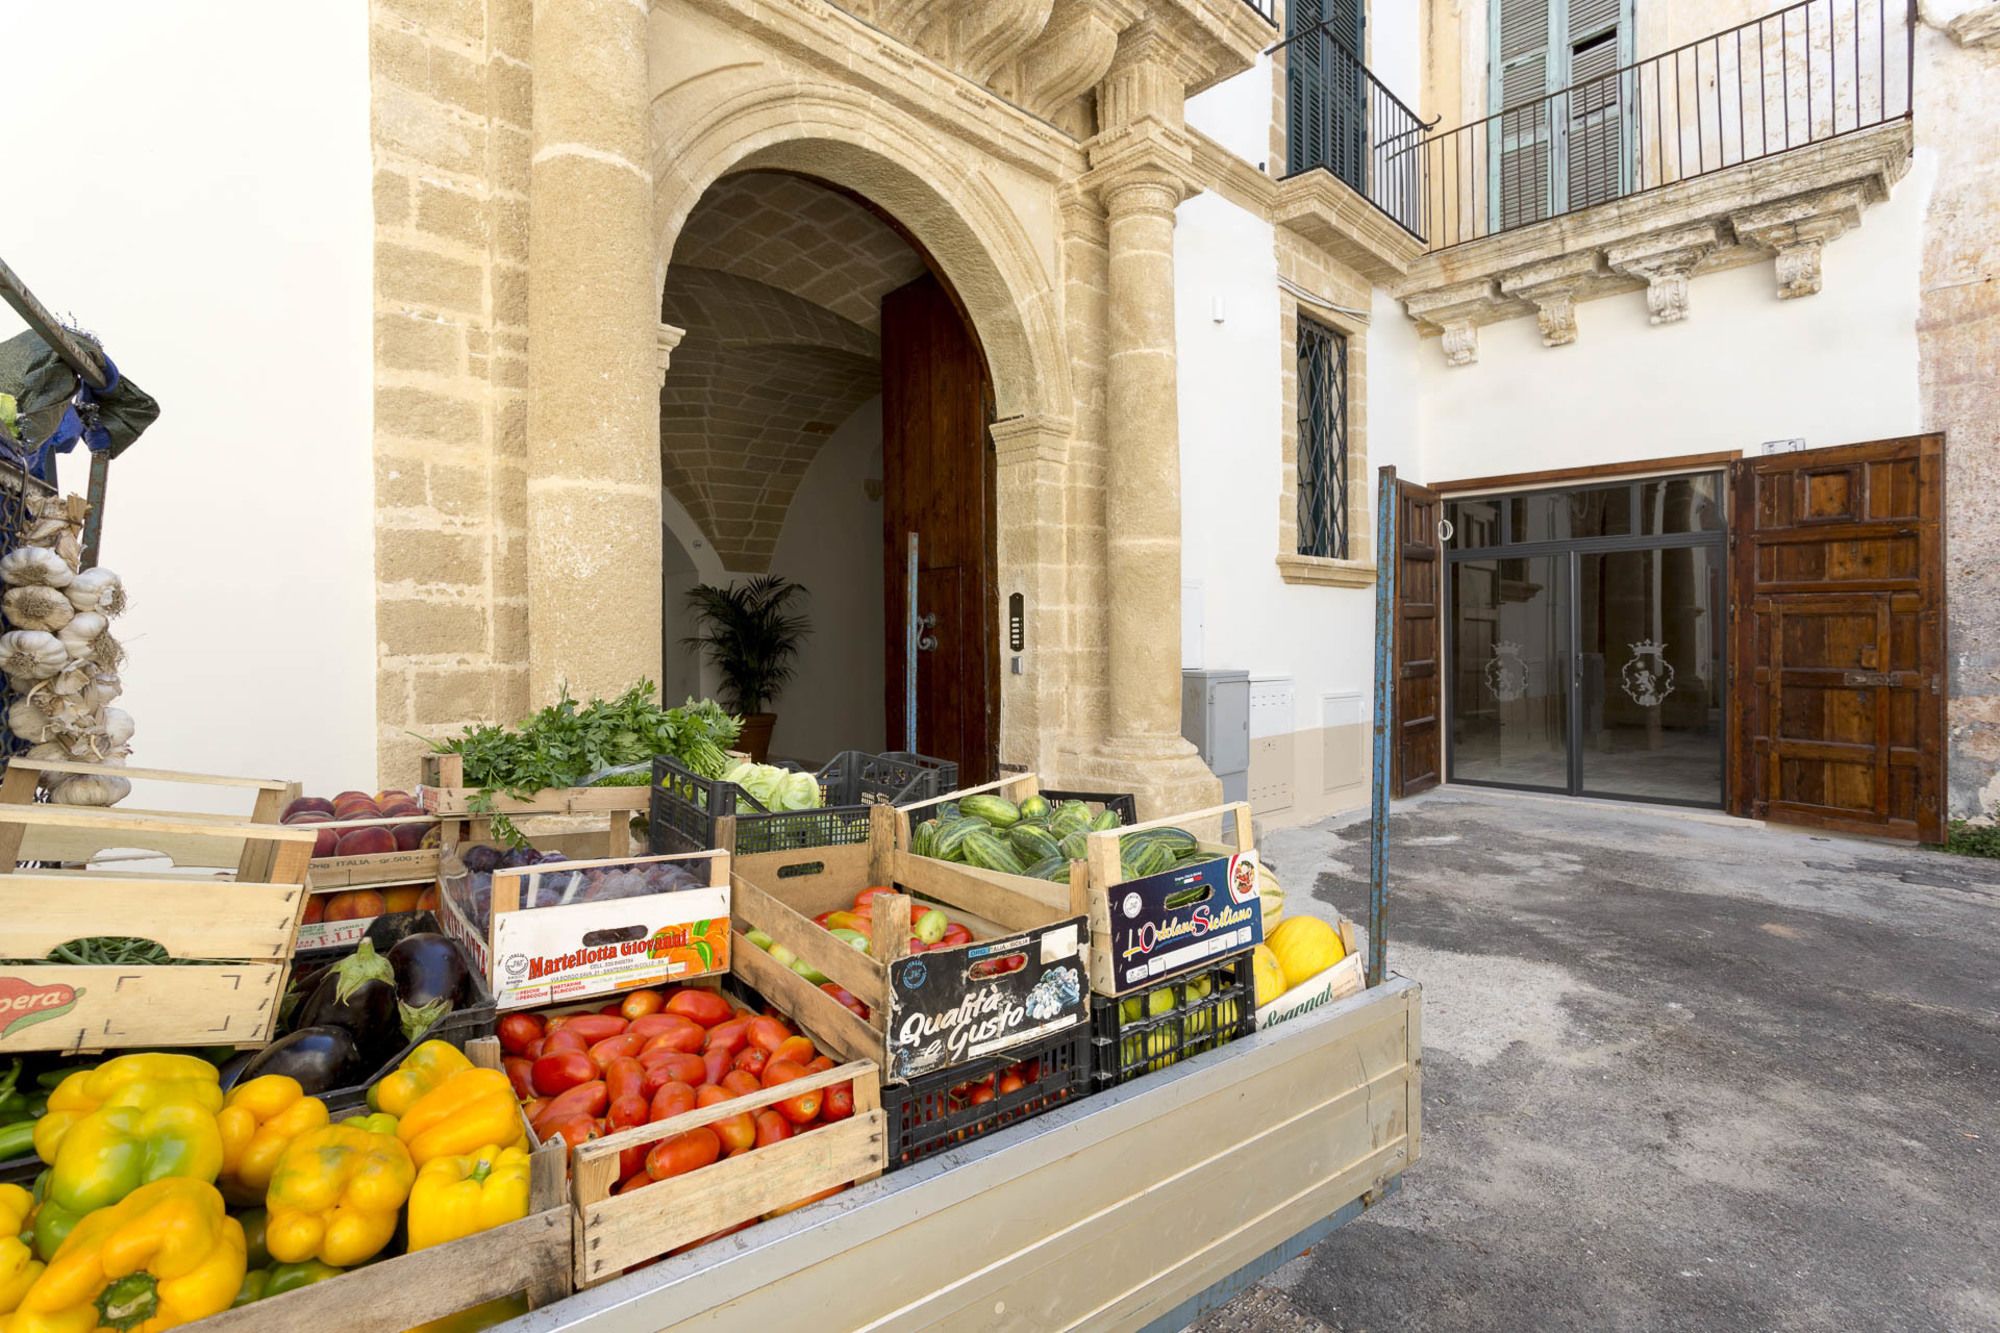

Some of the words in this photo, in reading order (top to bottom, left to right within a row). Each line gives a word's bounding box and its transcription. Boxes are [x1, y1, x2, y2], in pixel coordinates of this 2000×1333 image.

[1191, 904, 1252, 936] Siciliano
[528, 945, 618, 980] Martellotta
[620, 928, 687, 957] Giovanni
[900, 983, 1002, 1047] Qualità
[924, 1038, 942, 1059] e
[947, 1002, 1025, 1061] Gusto
